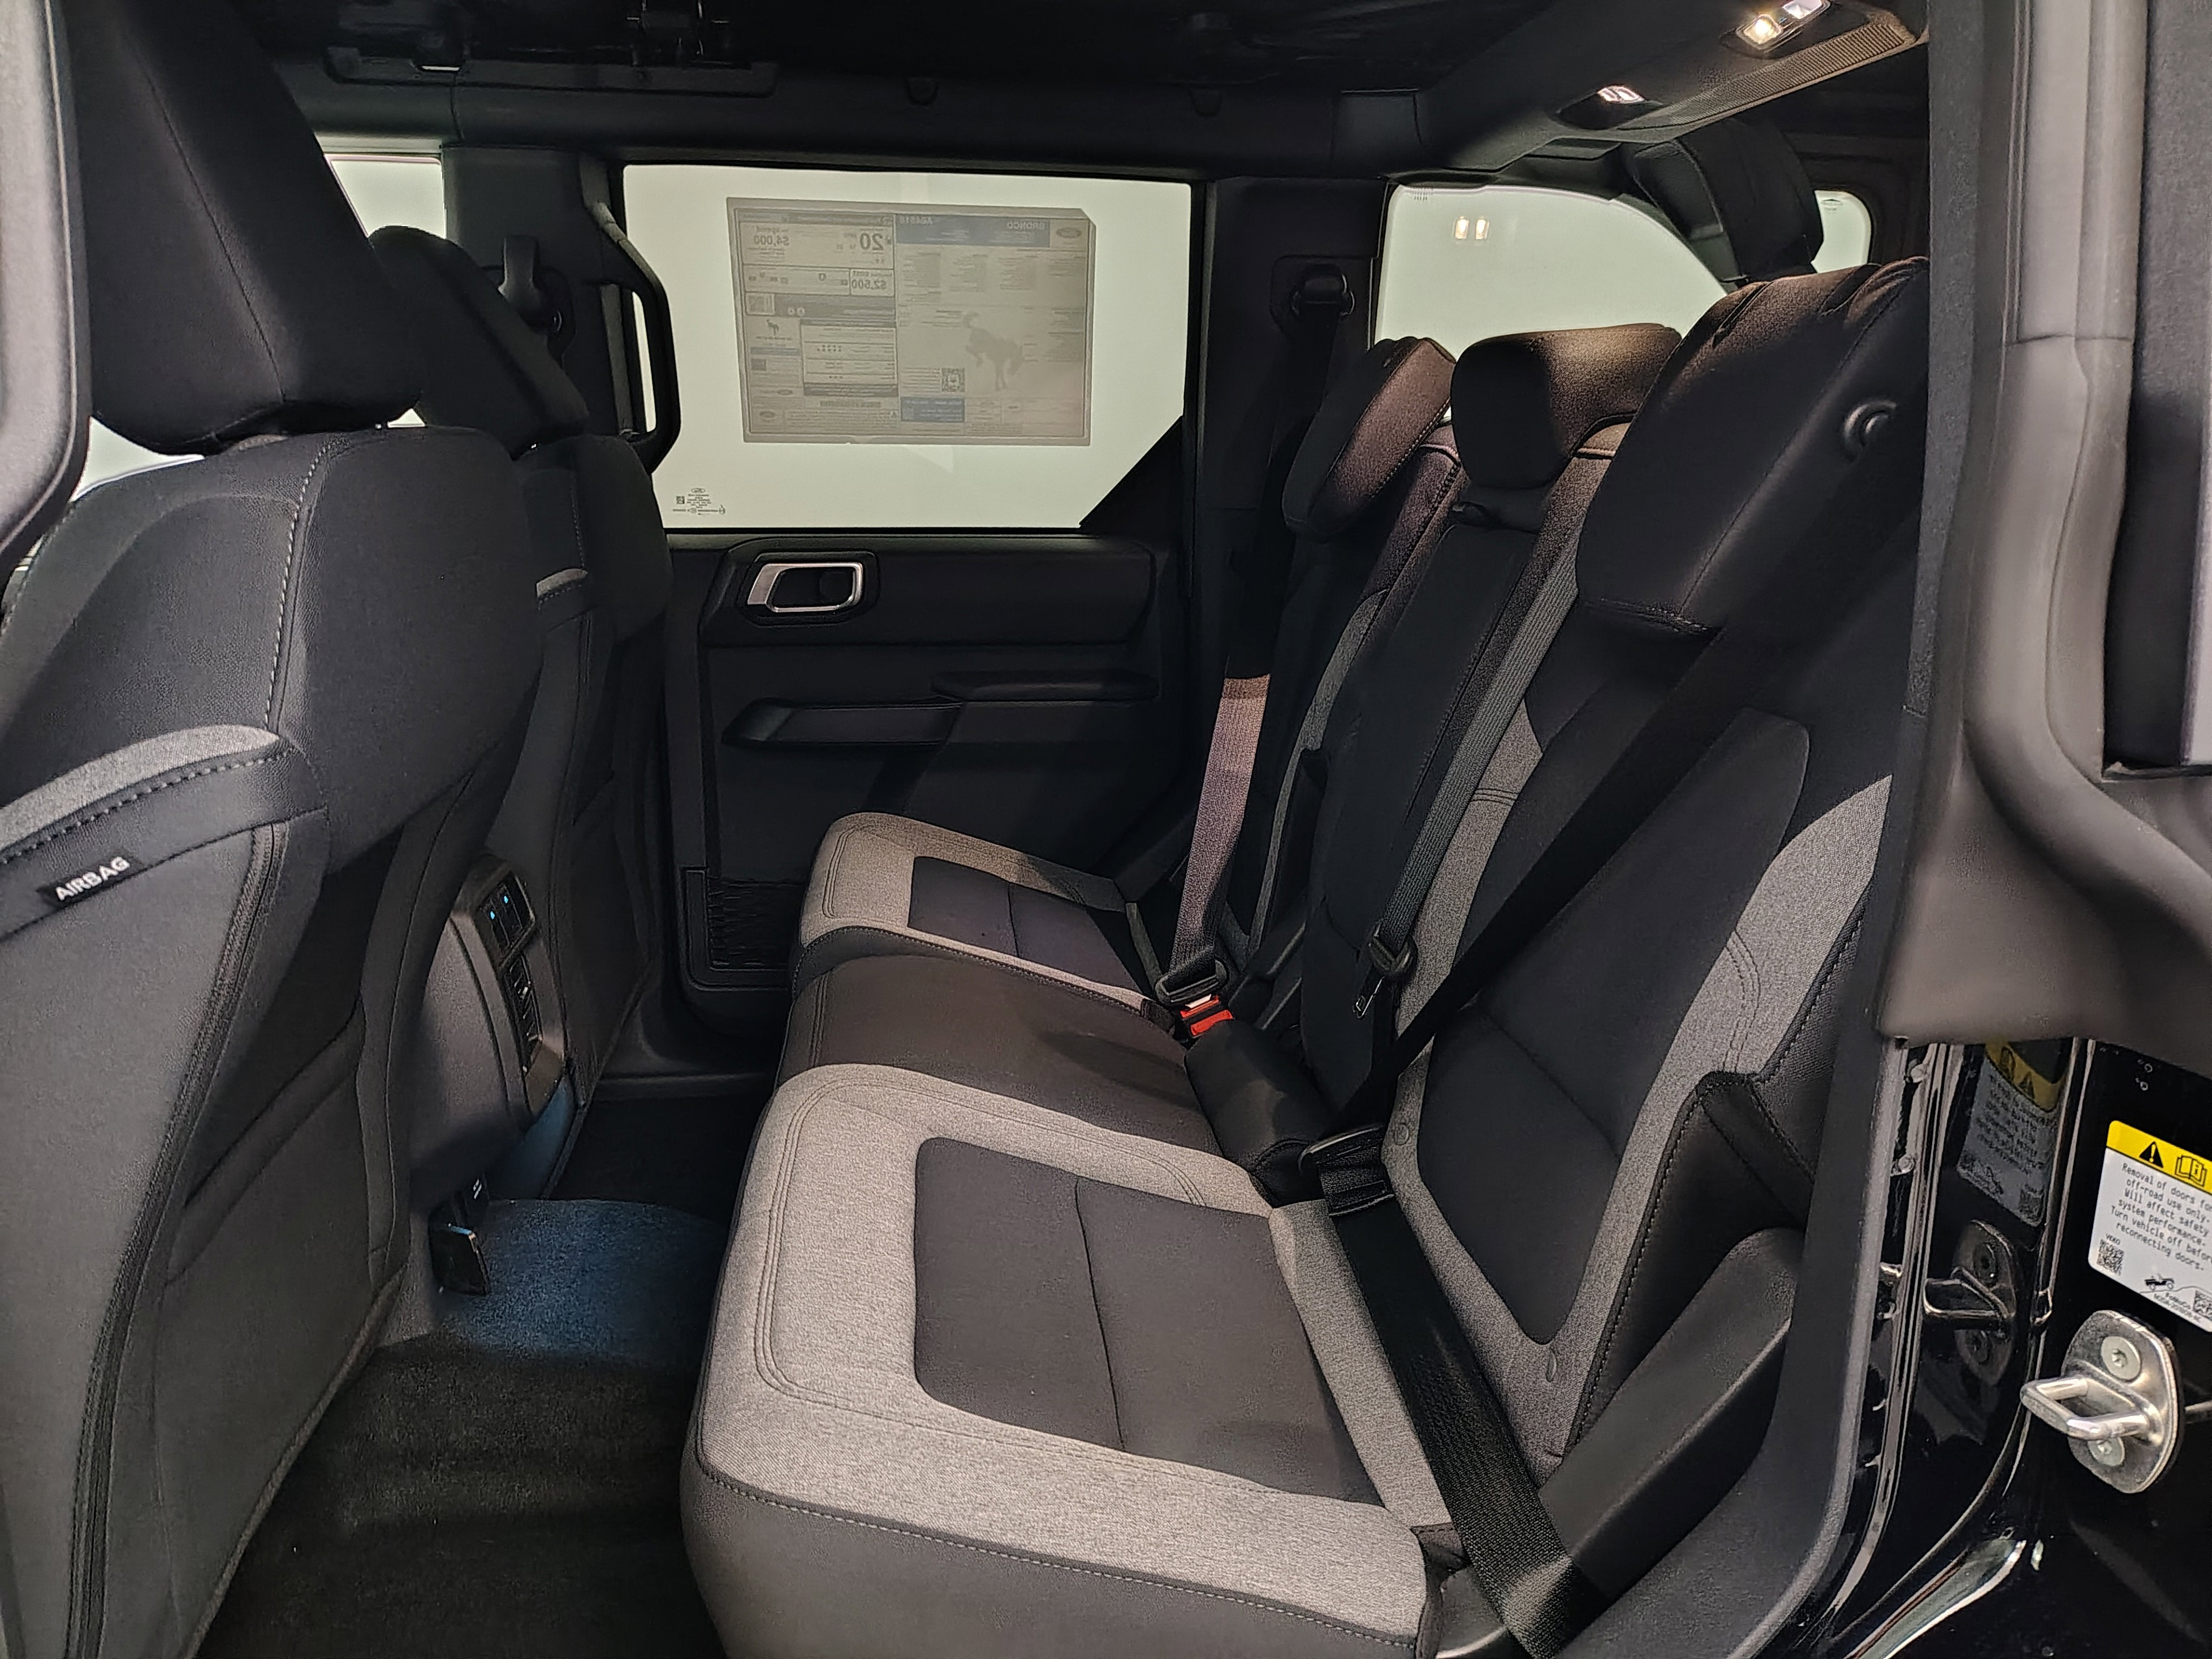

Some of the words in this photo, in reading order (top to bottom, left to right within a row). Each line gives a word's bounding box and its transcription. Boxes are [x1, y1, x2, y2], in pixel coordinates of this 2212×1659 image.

[56, 856, 131, 901] AIRBAG
[2122, 1162, 2154, 1185] Removal
[2156, 1181, 2167, 1191] of
[2171, 1187, 2195, 1204] doors
[2126, 1179, 2163, 1202] off-road
[2167, 1198, 2182, 1211] use
[2186, 1208, 2210, 1223] only.
[2111, 1205, 2128, 1221] Turn
[2132, 1218, 2164, 1238] vehicle
[2167, 1236, 2182, 1247] off
[2186, 1243, 2212, 1263] befor
[2118, 1199, 2145, 1218] system
[2148, 1214, 2206, 1246] performance.
[2125, 1188, 2142, 1204] Will
[2147, 1201, 2175, 1220] affect
[2179, 1216, 2209, 1237] safety
[2116, 1222, 2171, 1257] reconnecting
[2175, 1251, 2204, 1271] doors.
